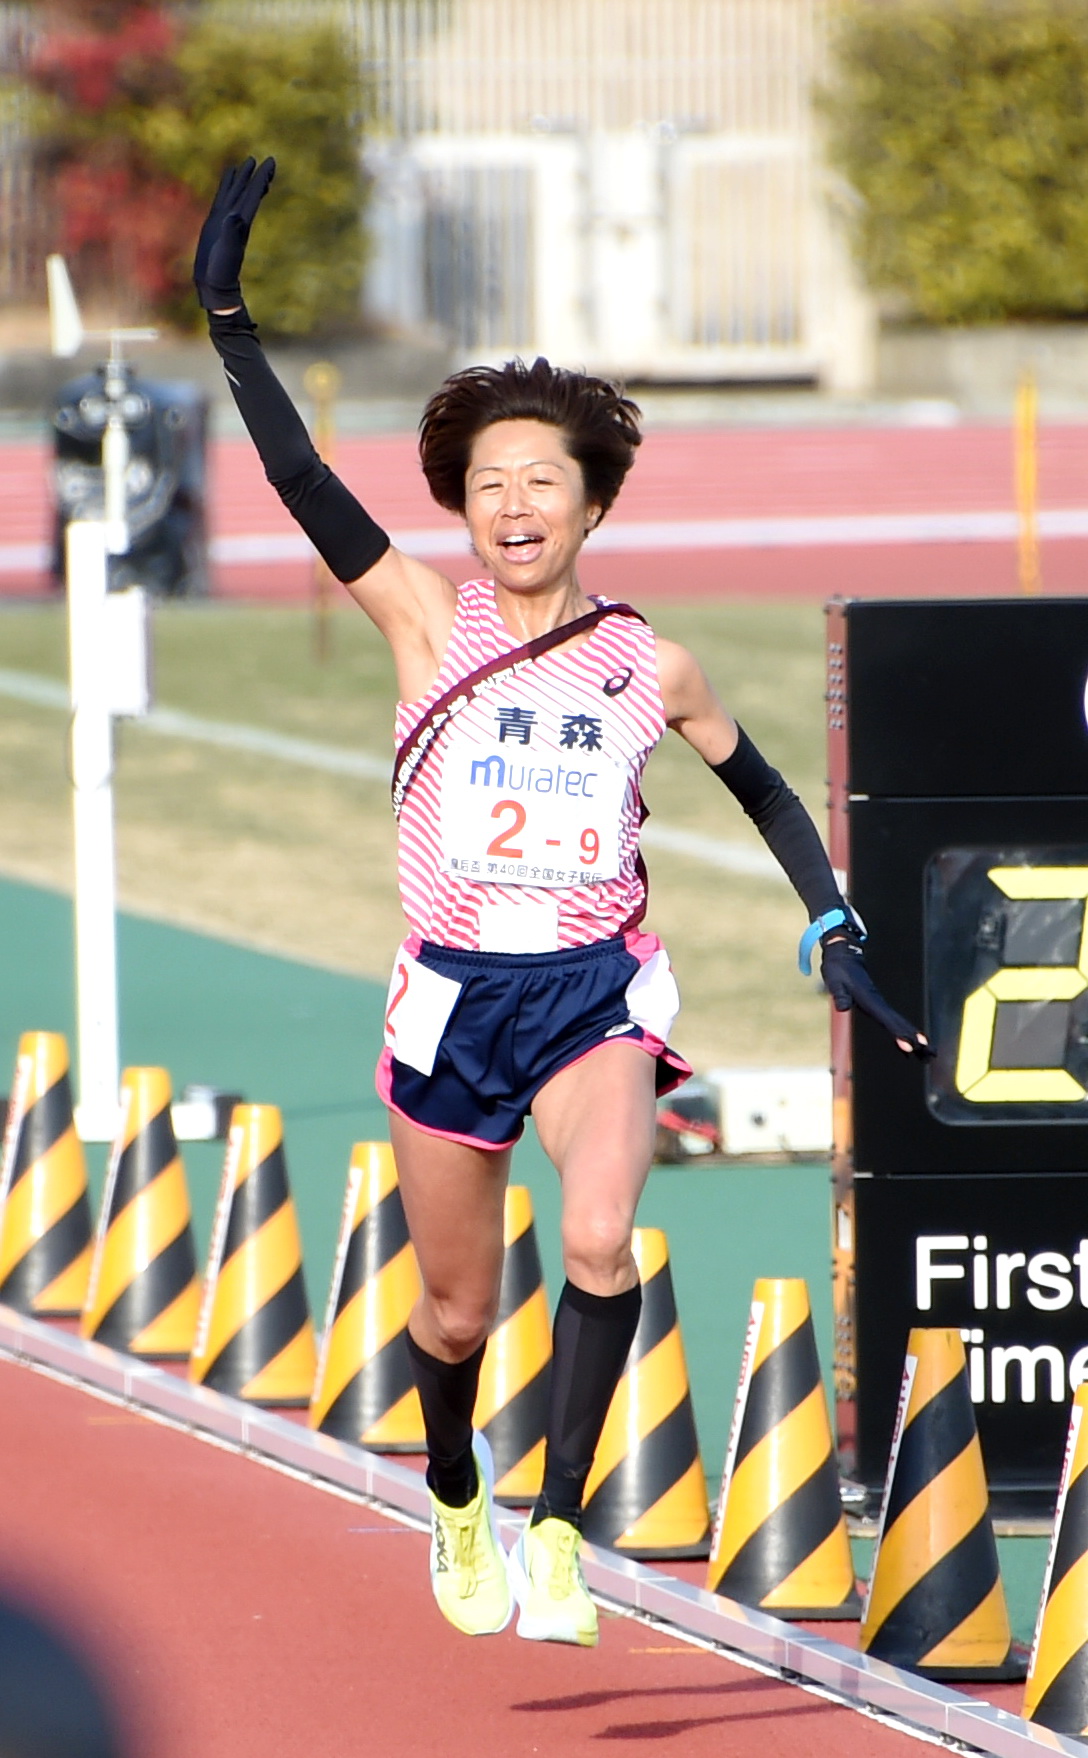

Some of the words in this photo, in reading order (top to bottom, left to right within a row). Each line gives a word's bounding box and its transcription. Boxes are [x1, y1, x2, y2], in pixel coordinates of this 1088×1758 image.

[494, 706, 604, 751] 青森
[470, 755, 598, 798] muratec
[956, 866, 1088, 1103] 2
